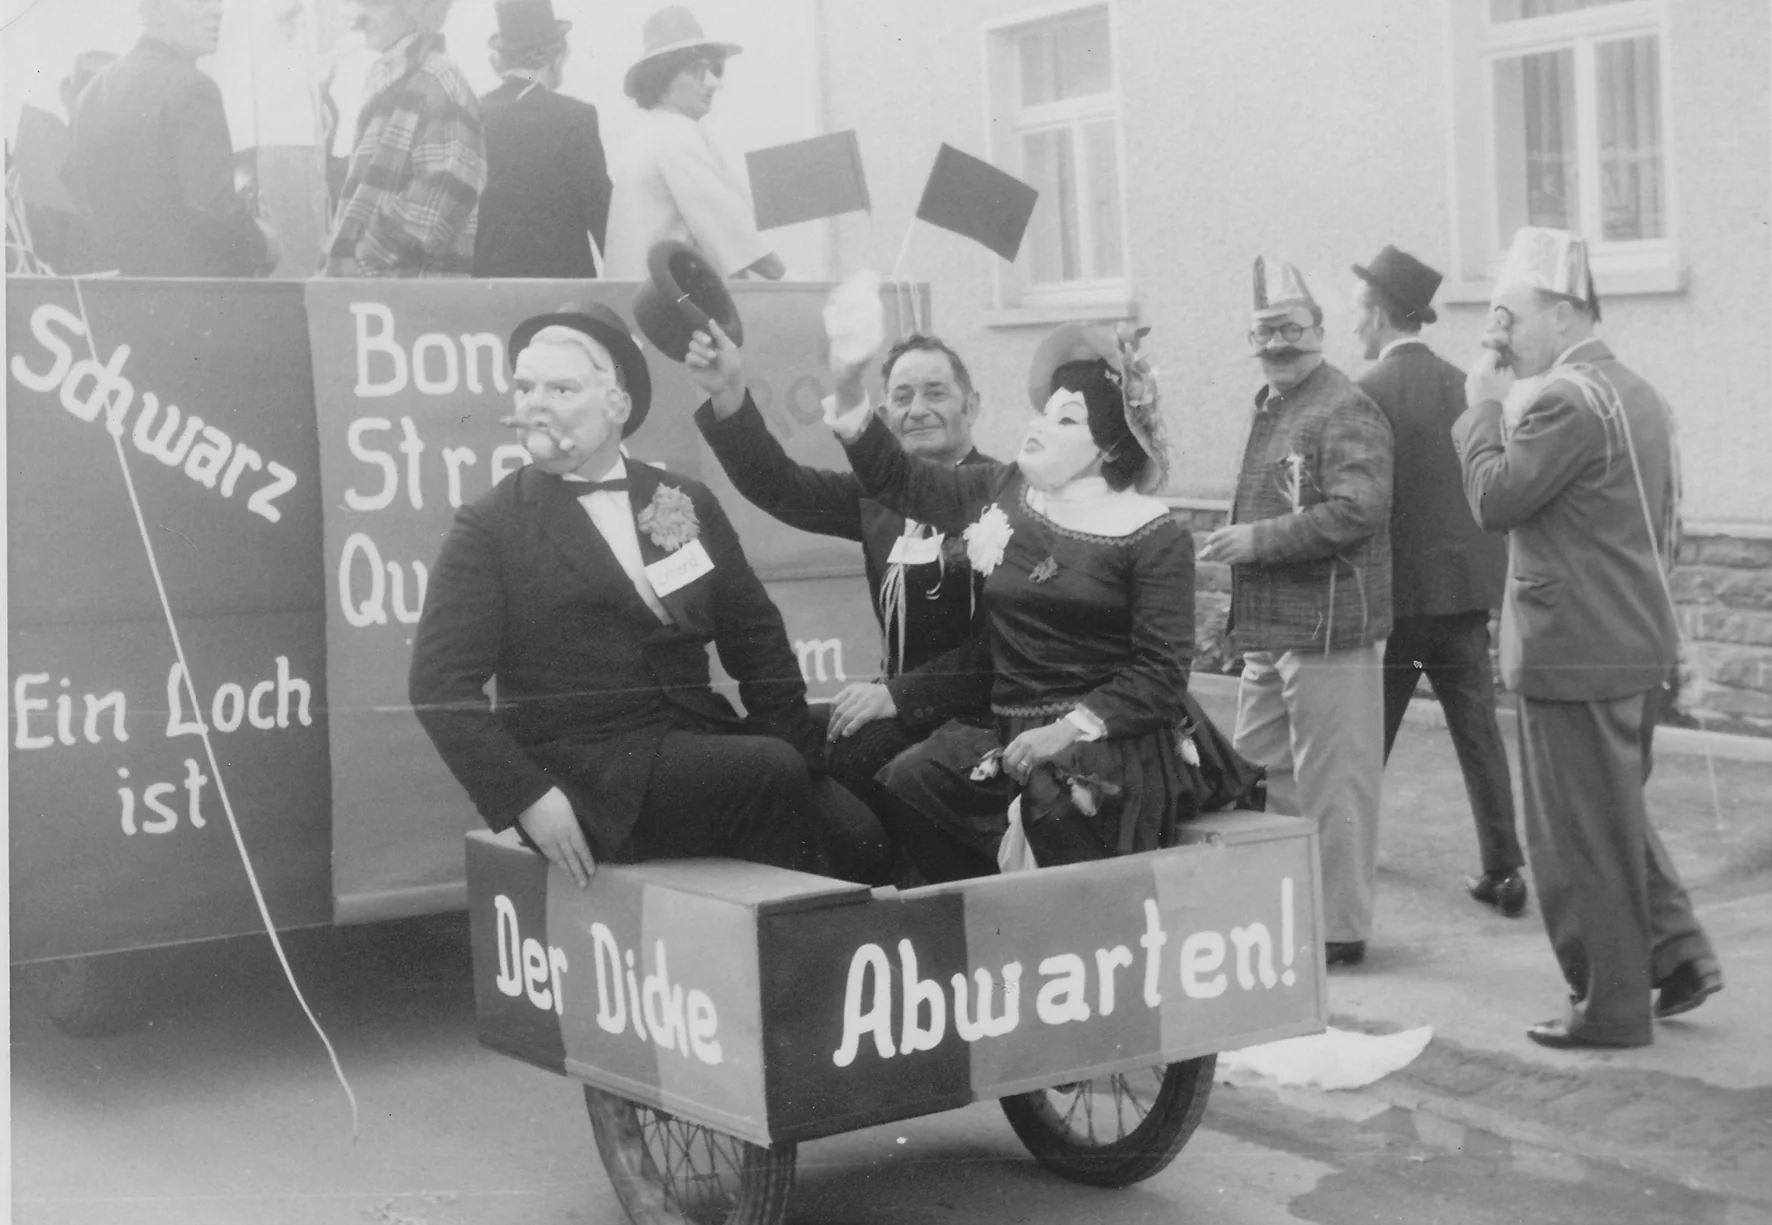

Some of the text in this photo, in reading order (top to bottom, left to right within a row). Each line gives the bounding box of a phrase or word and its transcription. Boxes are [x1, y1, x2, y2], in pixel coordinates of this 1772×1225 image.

[351, 301, 511, 397] Bon
[10, 304, 298, 523] Schwarz
[340, 533, 426, 627] Qu
[14, 655, 313, 751] Ein Loch
[118, 758, 208, 836] ist
[494, 893, 723, 1065] Der Dicke
[833, 876, 1297, 1068] Abwarten!
